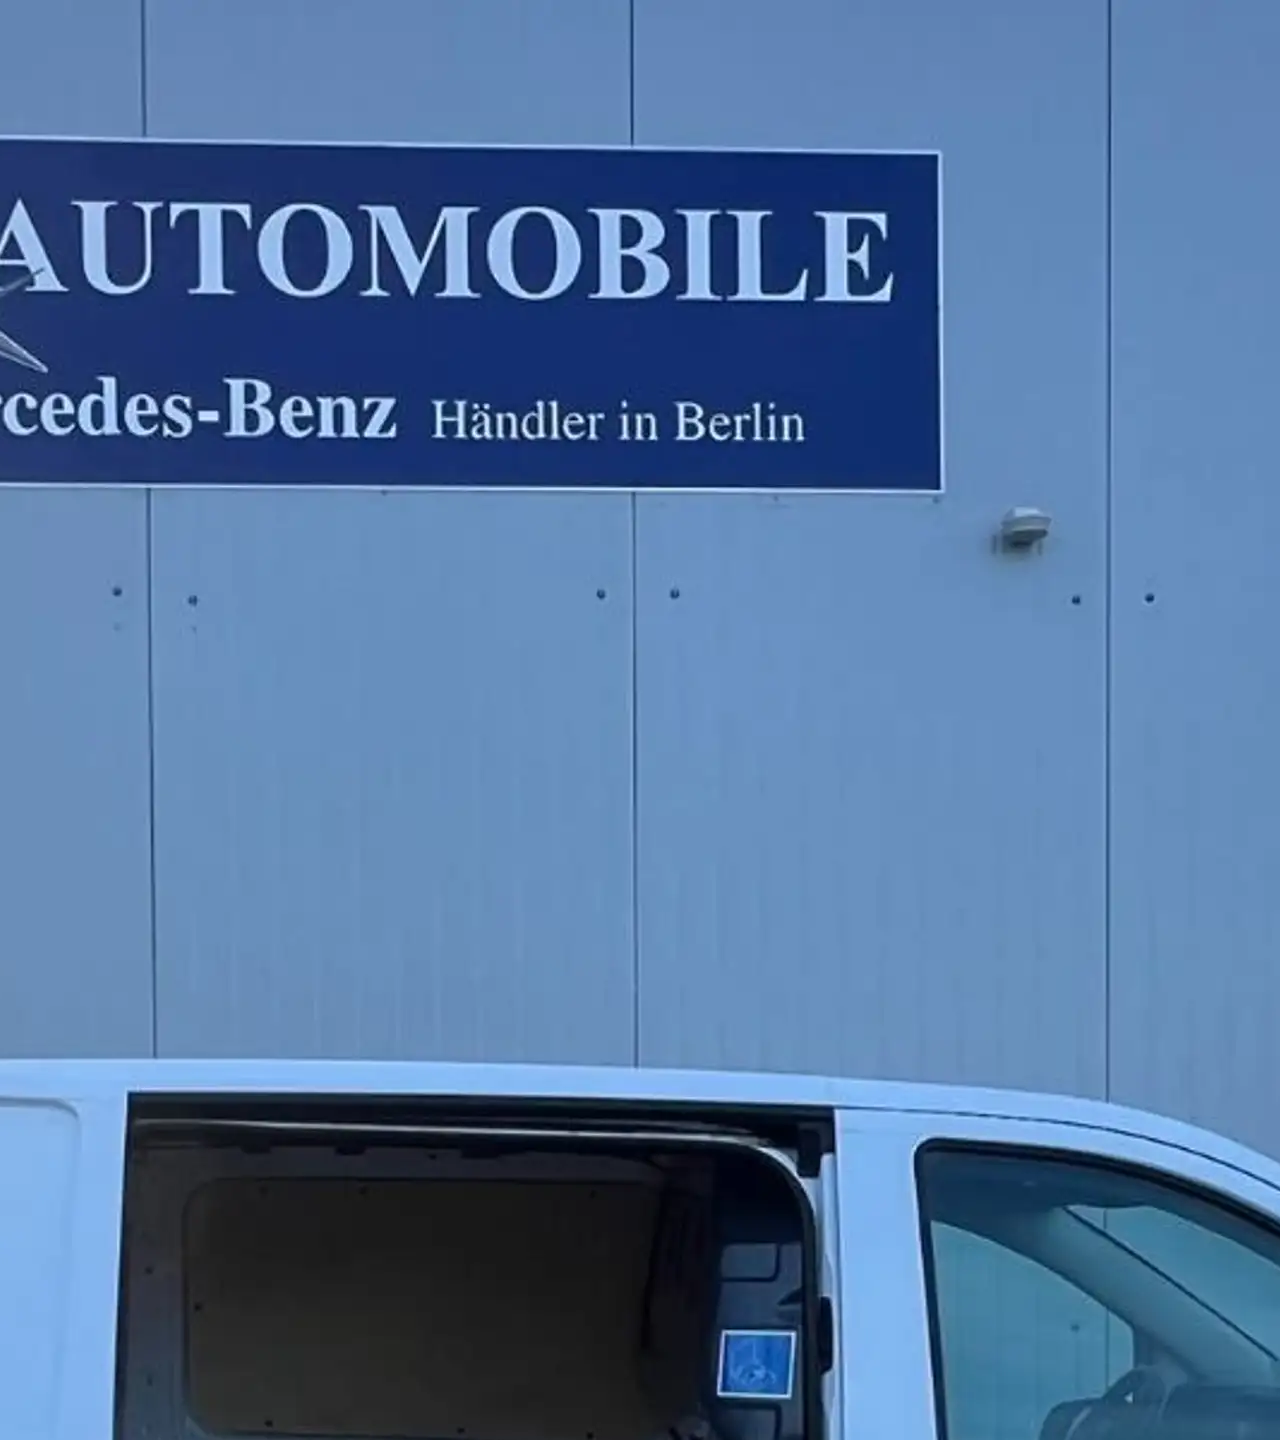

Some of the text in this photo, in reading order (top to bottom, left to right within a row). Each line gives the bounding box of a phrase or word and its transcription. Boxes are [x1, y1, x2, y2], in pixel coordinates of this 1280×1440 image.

[432, 399, 606, 441] Händler
[619, 402, 659, 442] in
[675, 403, 806, 443] Berlin
